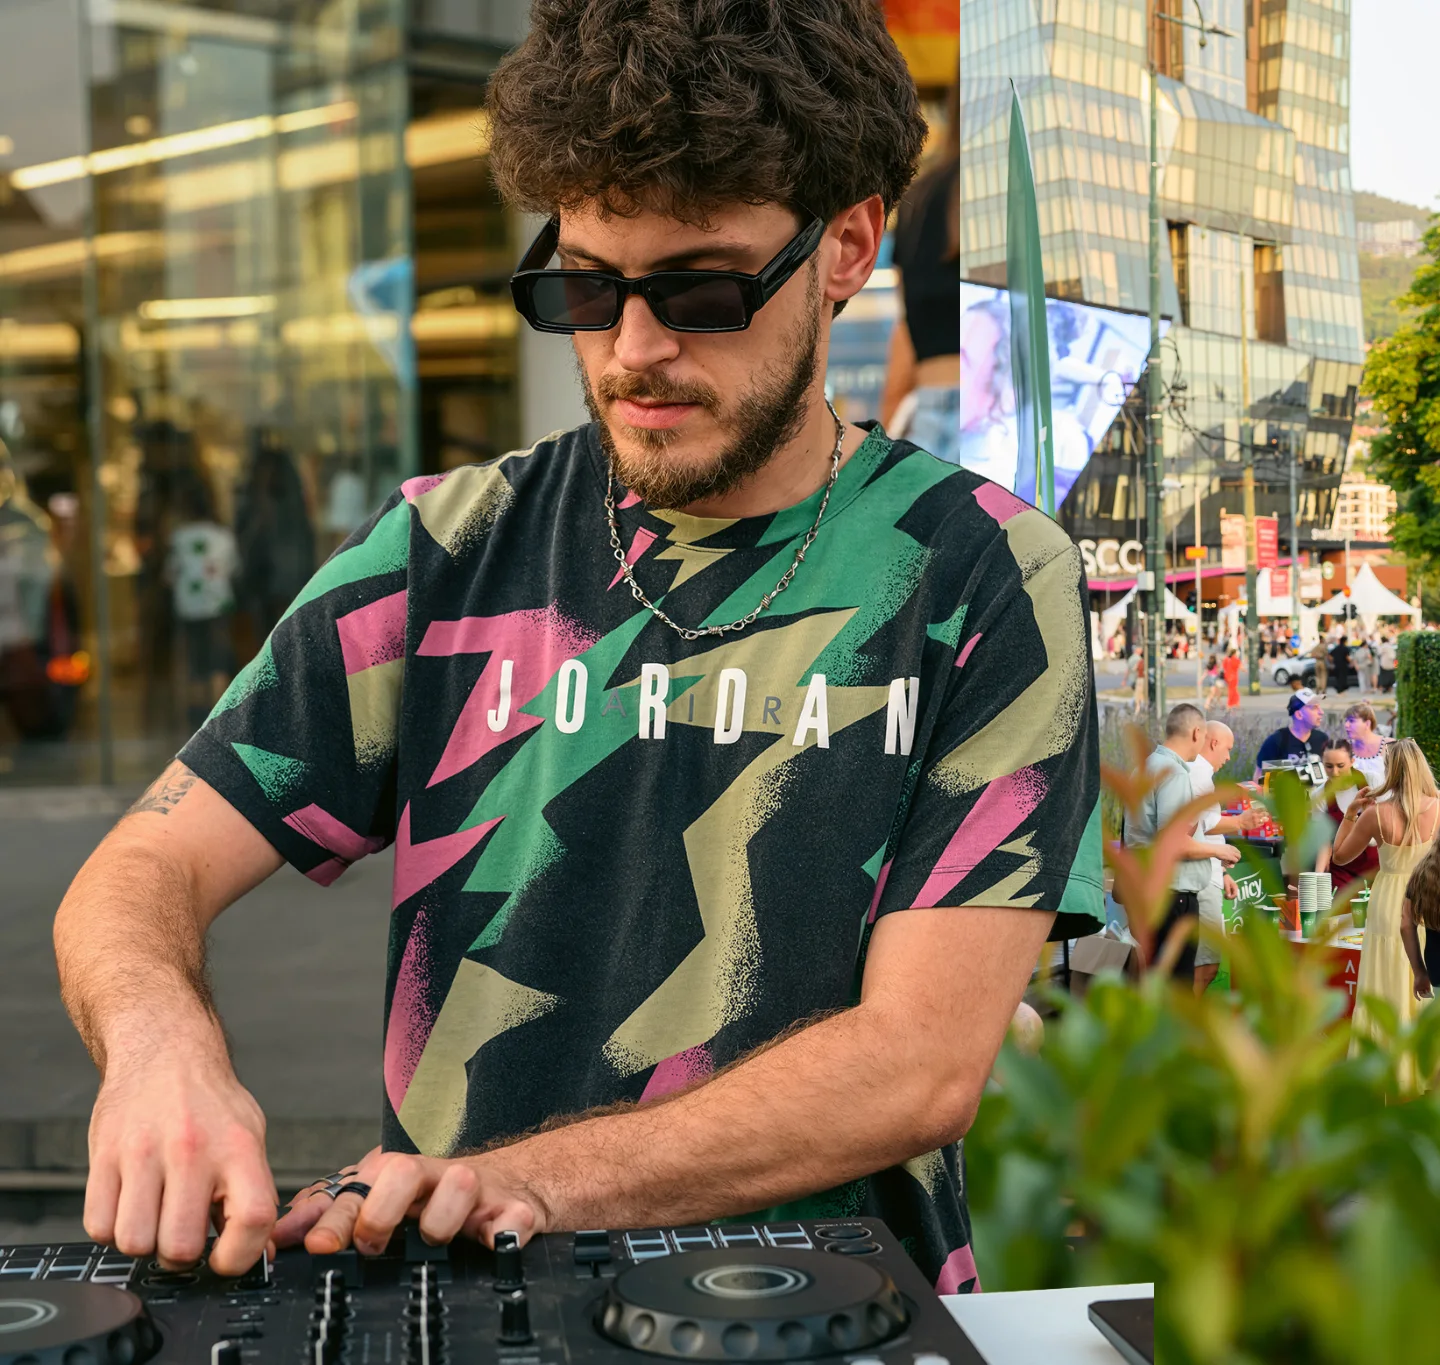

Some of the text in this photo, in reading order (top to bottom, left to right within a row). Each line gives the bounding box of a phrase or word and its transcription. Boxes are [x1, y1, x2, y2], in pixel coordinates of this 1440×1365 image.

[1078, 538, 1143, 574] SCC
[487, 659, 919, 755] JORDAN
[602, 686, 782, 725] AIR
